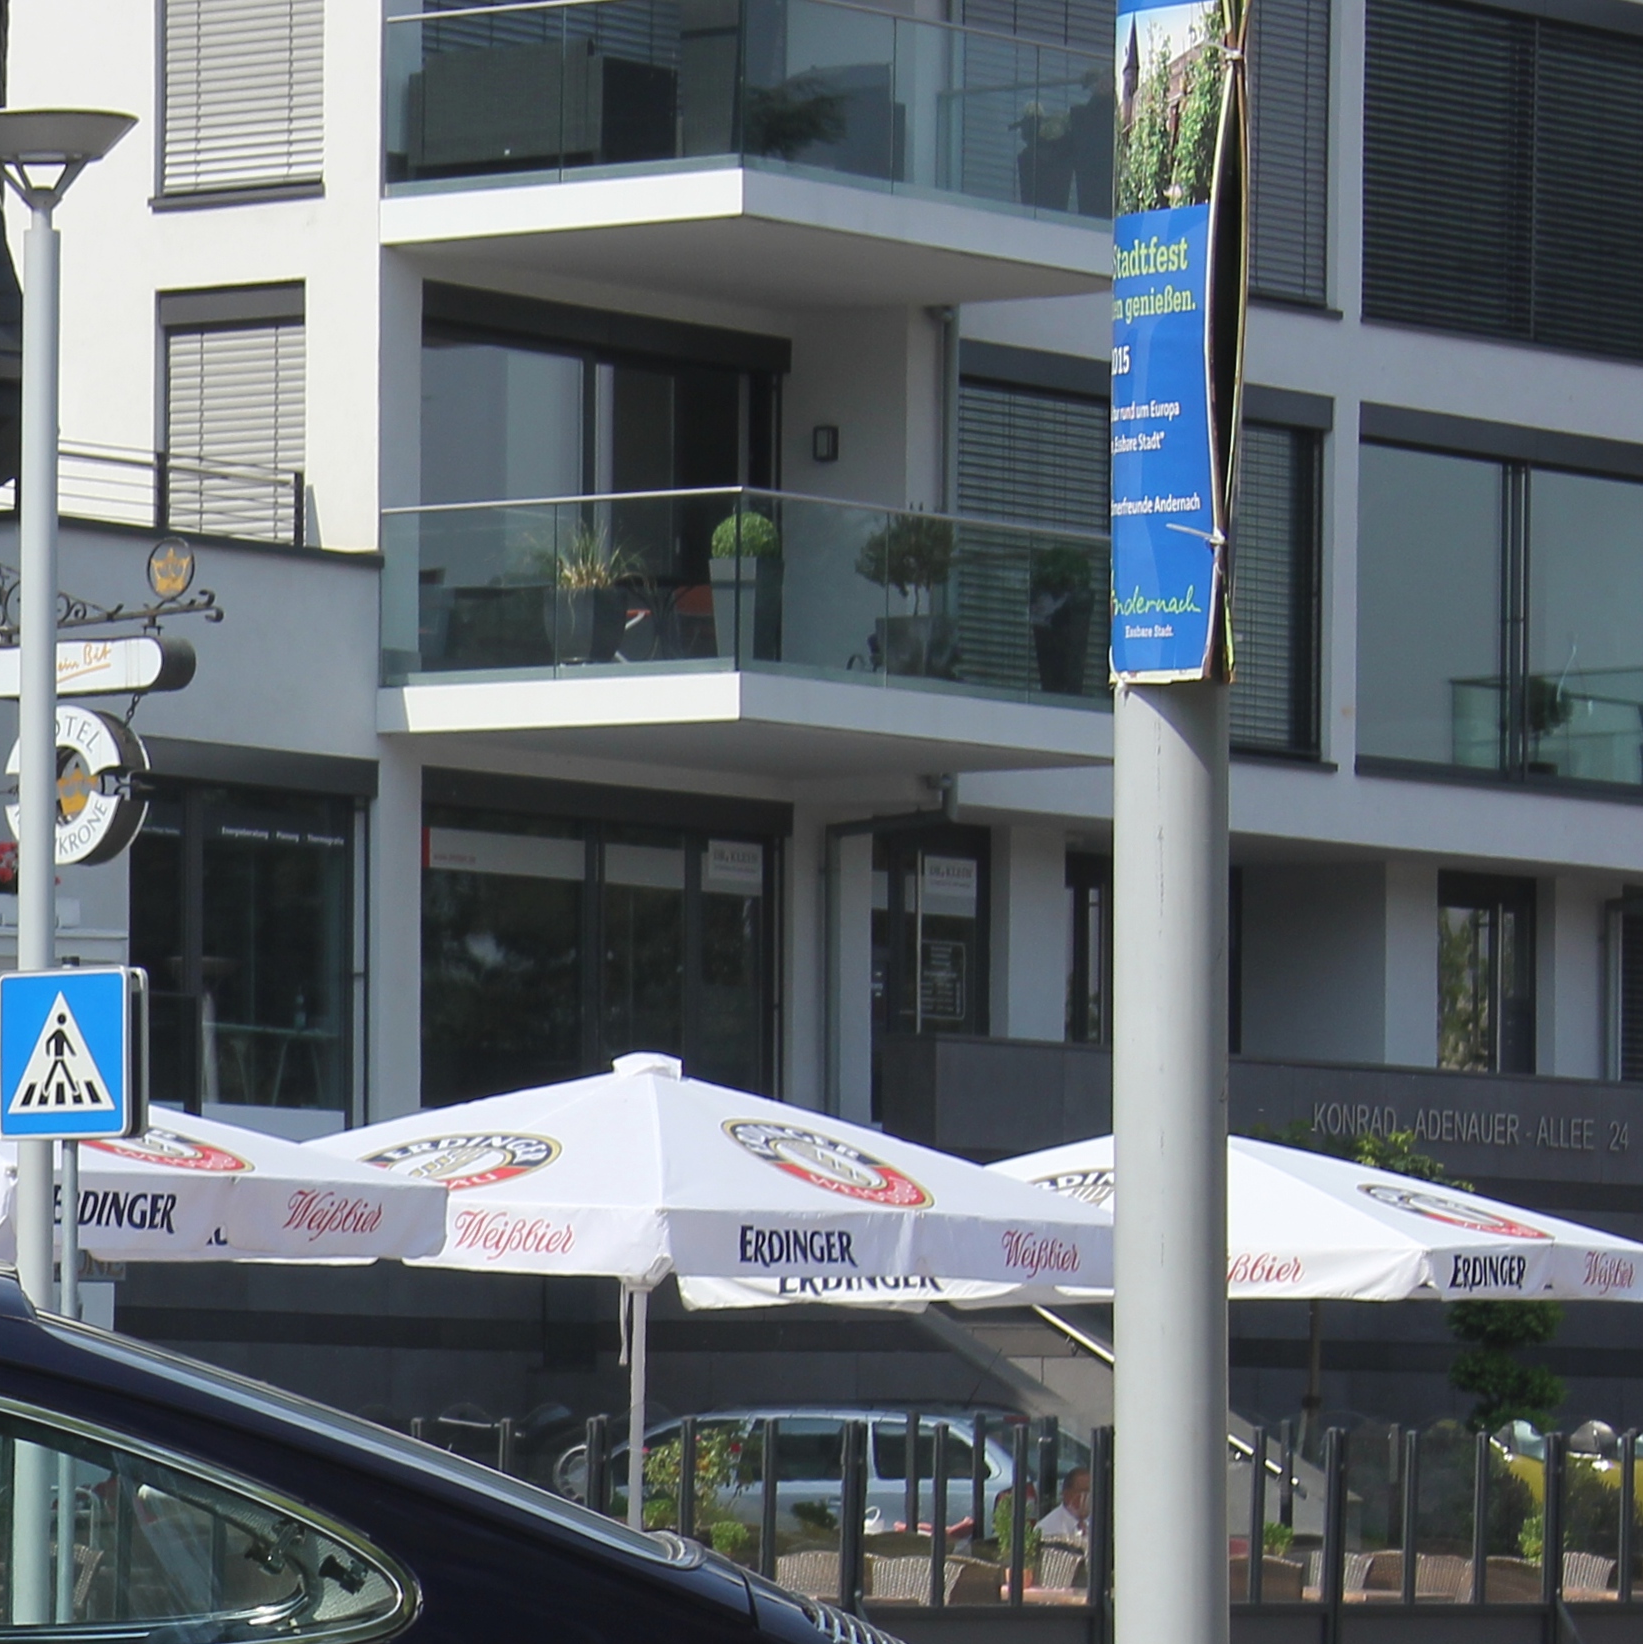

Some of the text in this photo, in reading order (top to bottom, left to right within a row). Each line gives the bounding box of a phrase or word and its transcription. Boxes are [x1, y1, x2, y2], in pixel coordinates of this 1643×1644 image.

[1125, 284, 1197, 325] genießen.
[1150, 399, 1180, 422] Europa
[1154, 492, 1201, 513] Andernach
[1112, 585, 1201, 617] ndernach
[1536, 1115, 1595, 1150] ALLEE
[1609, 1120, 1629, 1151] 24
[282, 1188, 384, 1242] Weißbier
[454, 1208, 576, 1261] Weißbier
[739, 1224, 858, 1268] ERDINGER
[1001, 1229, 1081, 1280] Weißbier
[1228, 1251, 1306, 1284] ßbier
[1449, 1254, 1527, 1292] ERDINGER
